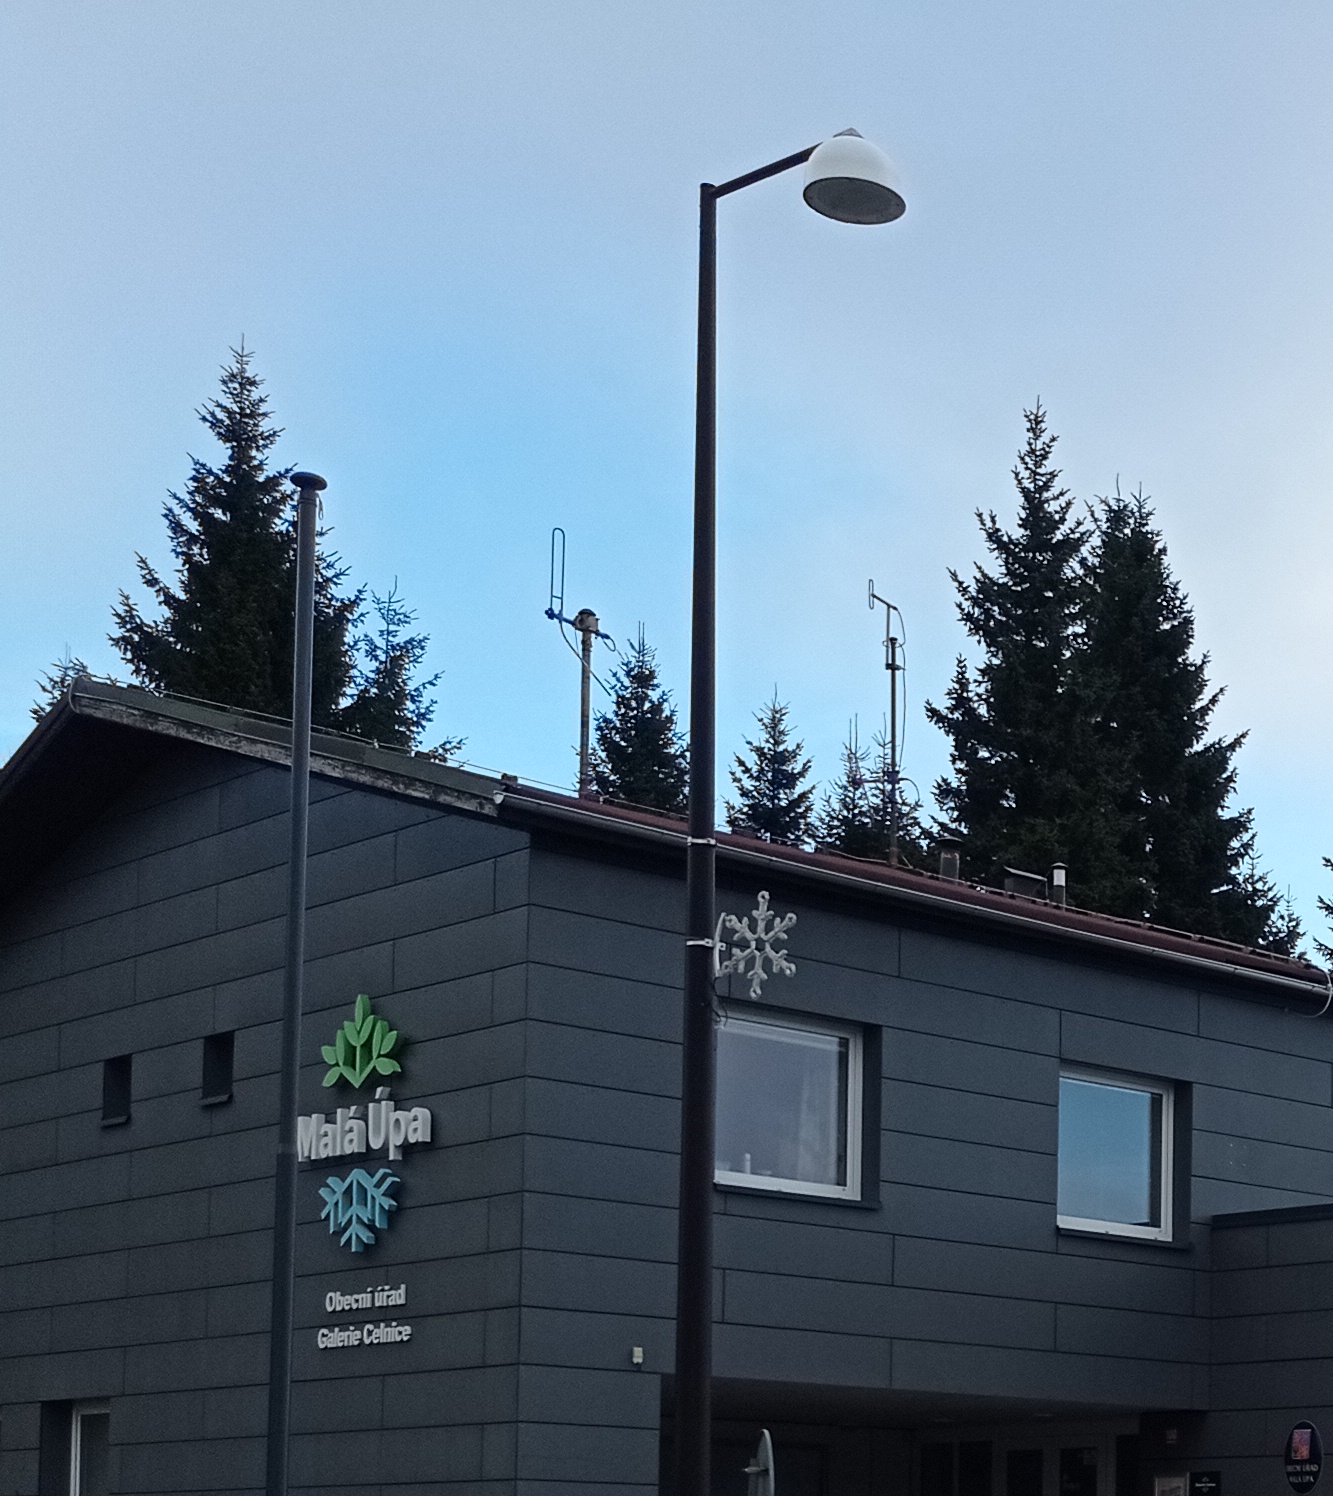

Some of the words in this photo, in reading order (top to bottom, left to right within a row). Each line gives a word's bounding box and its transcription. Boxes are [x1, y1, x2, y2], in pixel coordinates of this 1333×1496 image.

[297, 1105, 366, 1162] Malá
[368, 1086, 432, 1160] Úpa
[325, 1287, 373, 1312] Obecní
[374, 1284, 406, 1307] úřad
[318, 1326, 362, 1349] Galerie
[363, 1321, 412, 1345] Celnice
